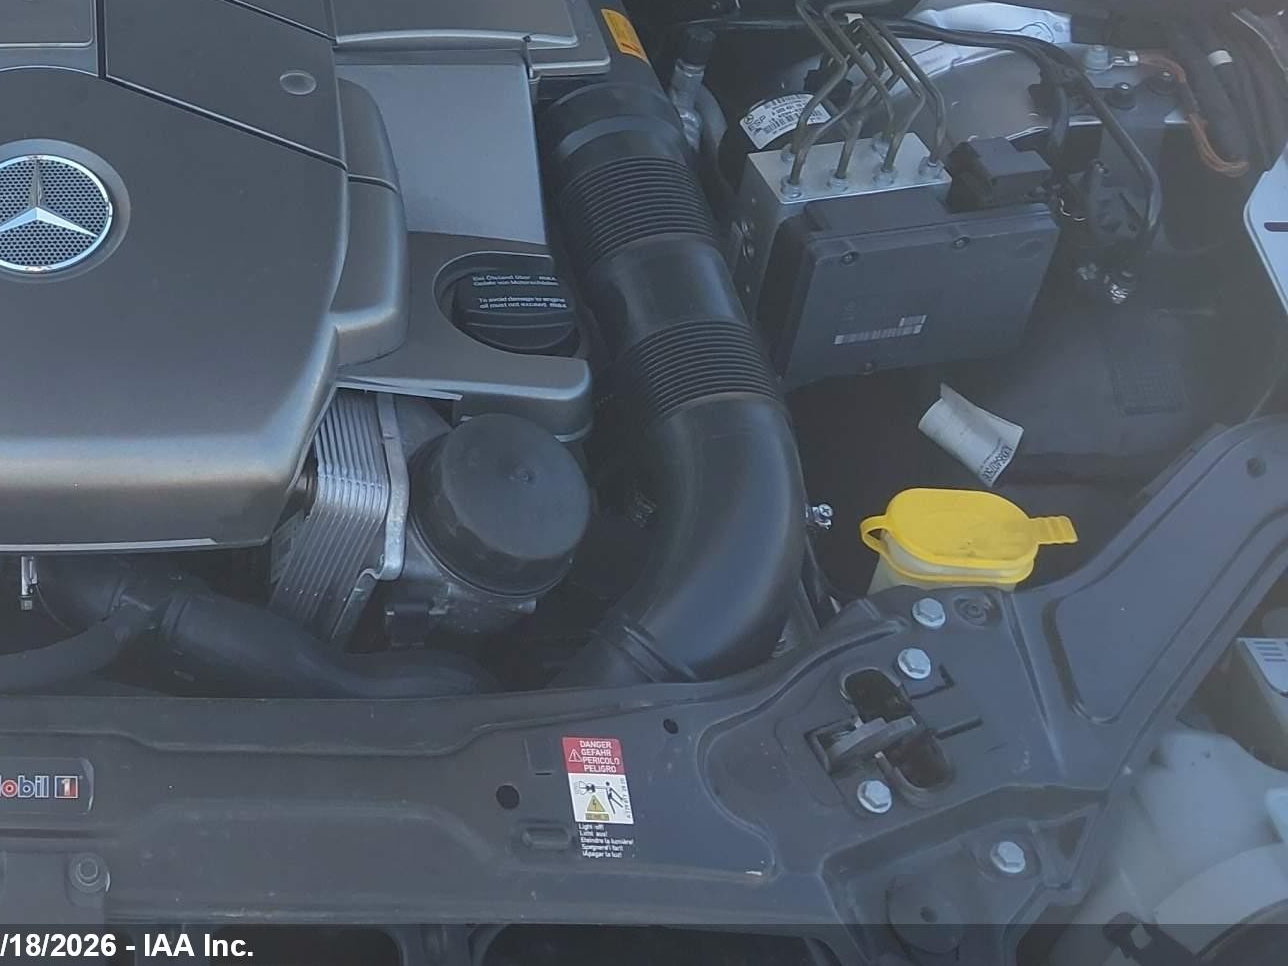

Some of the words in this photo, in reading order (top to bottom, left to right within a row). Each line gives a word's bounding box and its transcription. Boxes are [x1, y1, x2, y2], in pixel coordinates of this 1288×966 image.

[748, 115, 766, 132] ESP
[579, 740, 612, 749] DANGER
[580, 748, 612, 756] GEFAHR
[582, 756, 621, 765] PERICOLO
[583, 764, 617, 773] PELIGRO
